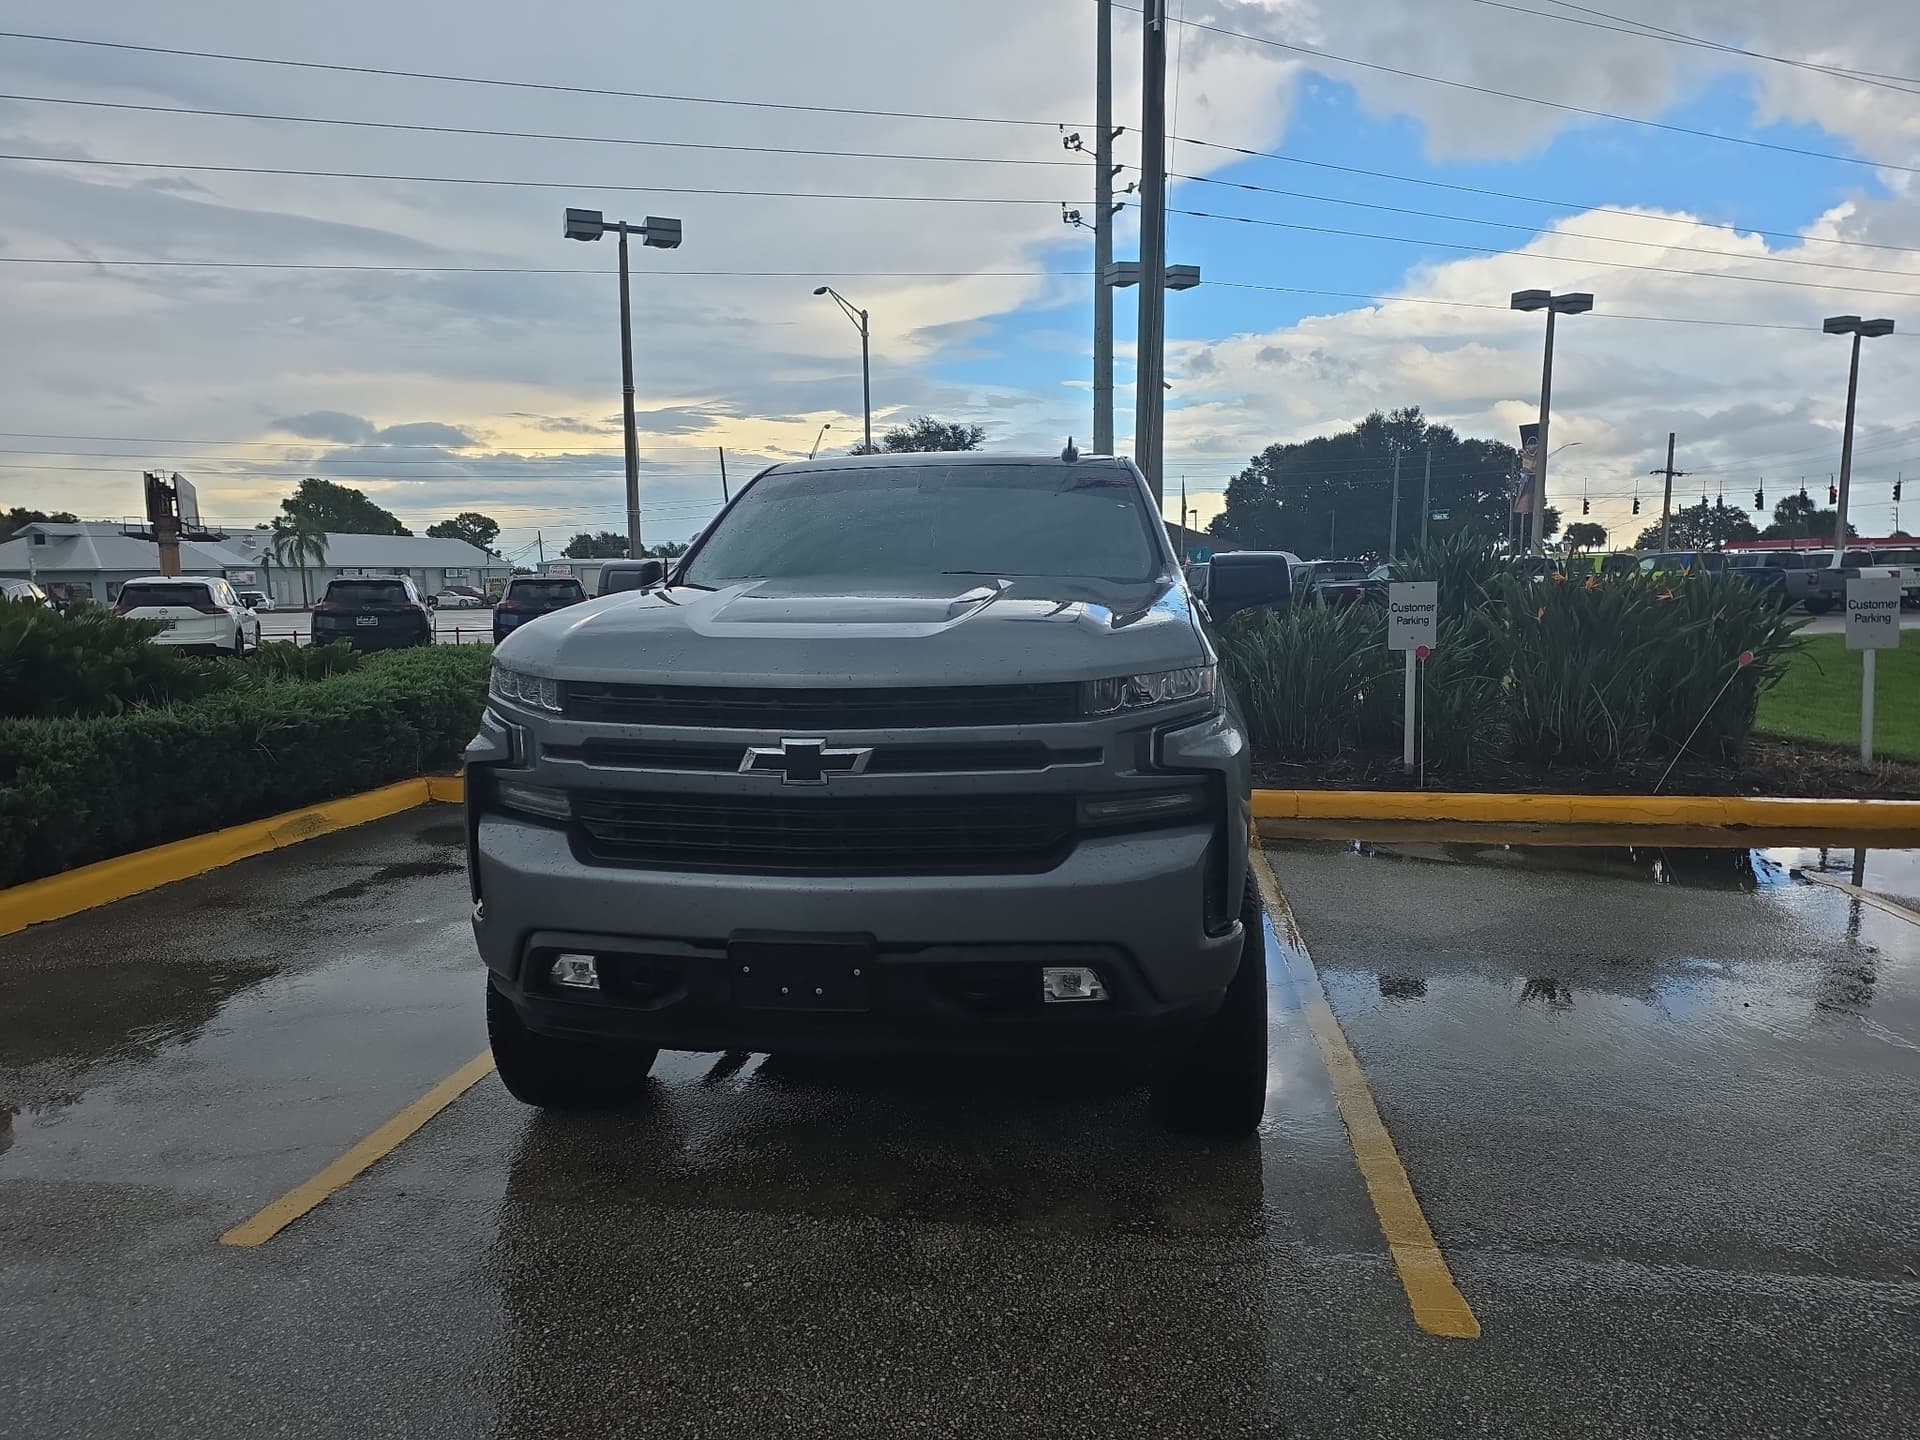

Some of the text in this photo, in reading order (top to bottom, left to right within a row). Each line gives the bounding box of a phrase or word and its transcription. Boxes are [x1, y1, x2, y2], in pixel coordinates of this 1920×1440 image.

[1391, 602, 1435, 612] Customer
[1848, 599, 1898, 610] Customer
[1396, 615, 1430, 627] Parking
[1854, 612, 1891, 625] Parking
